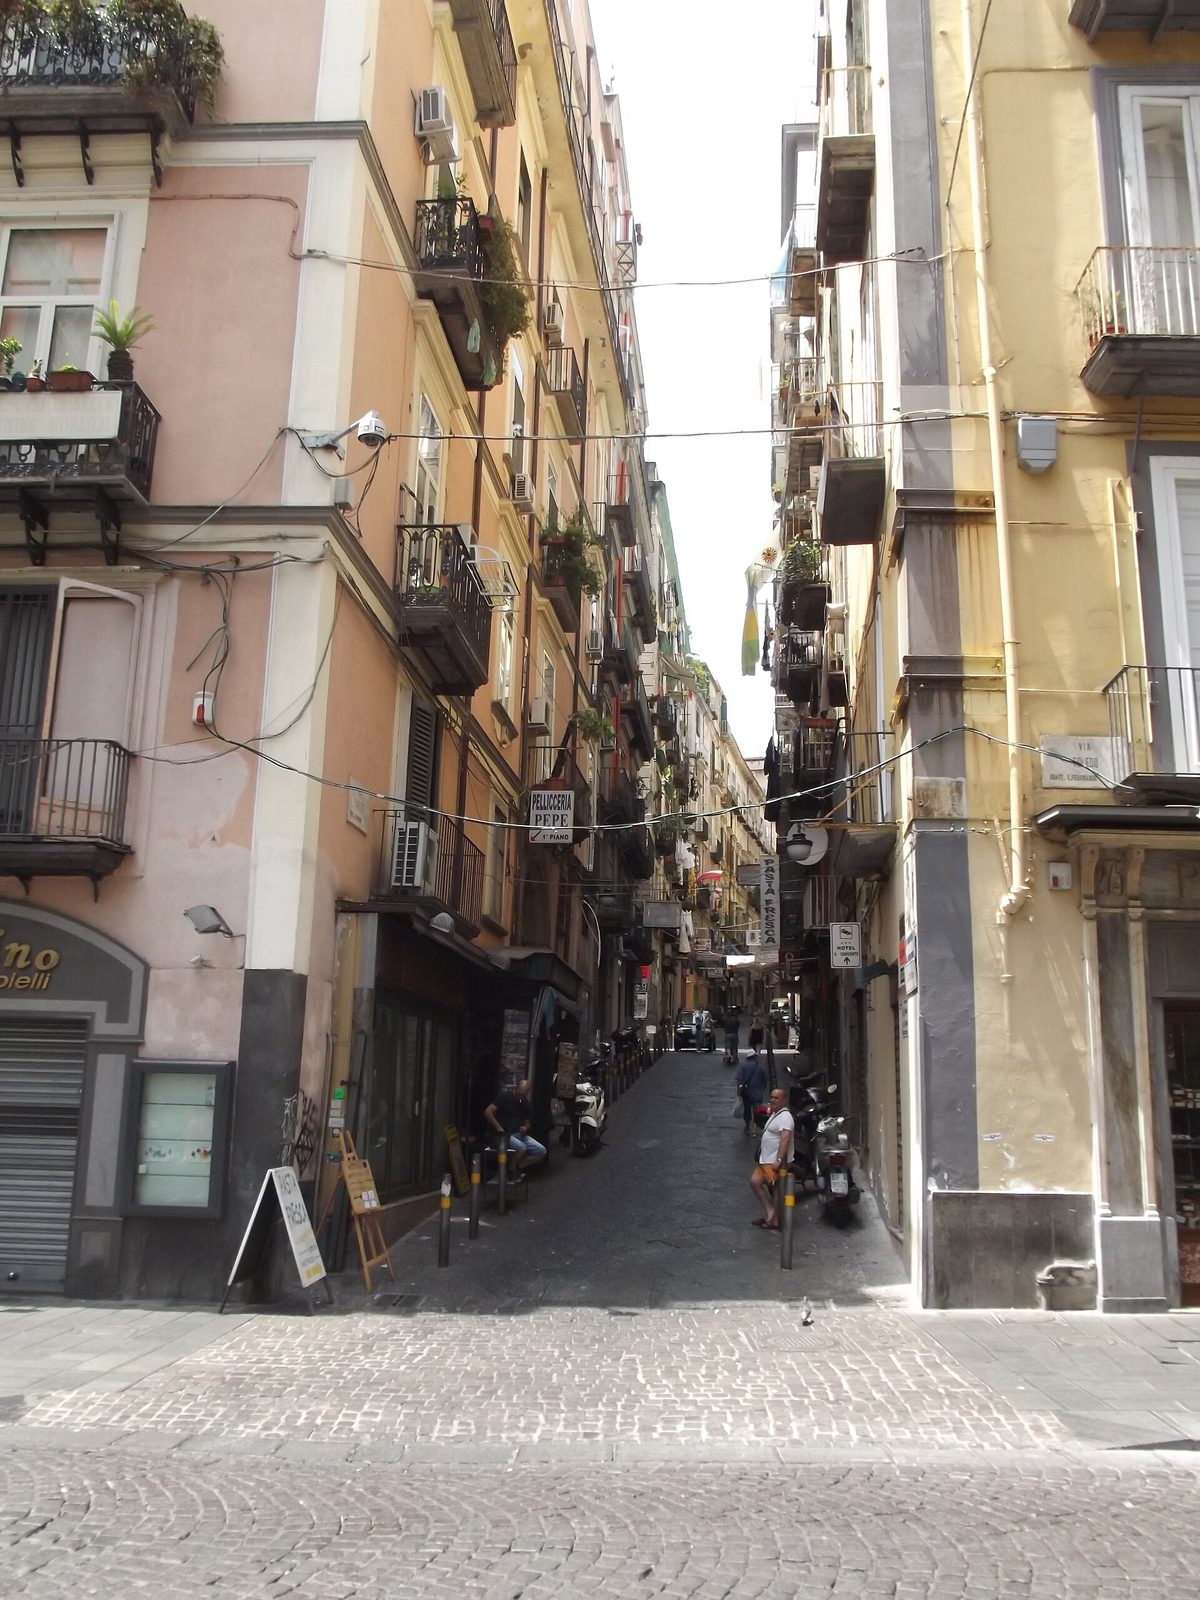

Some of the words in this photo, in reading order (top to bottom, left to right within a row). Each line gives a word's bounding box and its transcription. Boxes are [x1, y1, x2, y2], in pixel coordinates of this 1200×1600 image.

[1078, 742, 1091, 751] VIA
[532, 794, 571, 811] PELLICCERIA
[535, 814, 568, 827] PEPE
[764, 859, 775, 895] PASTA
[764, 900, 776, 944] FRESCA
